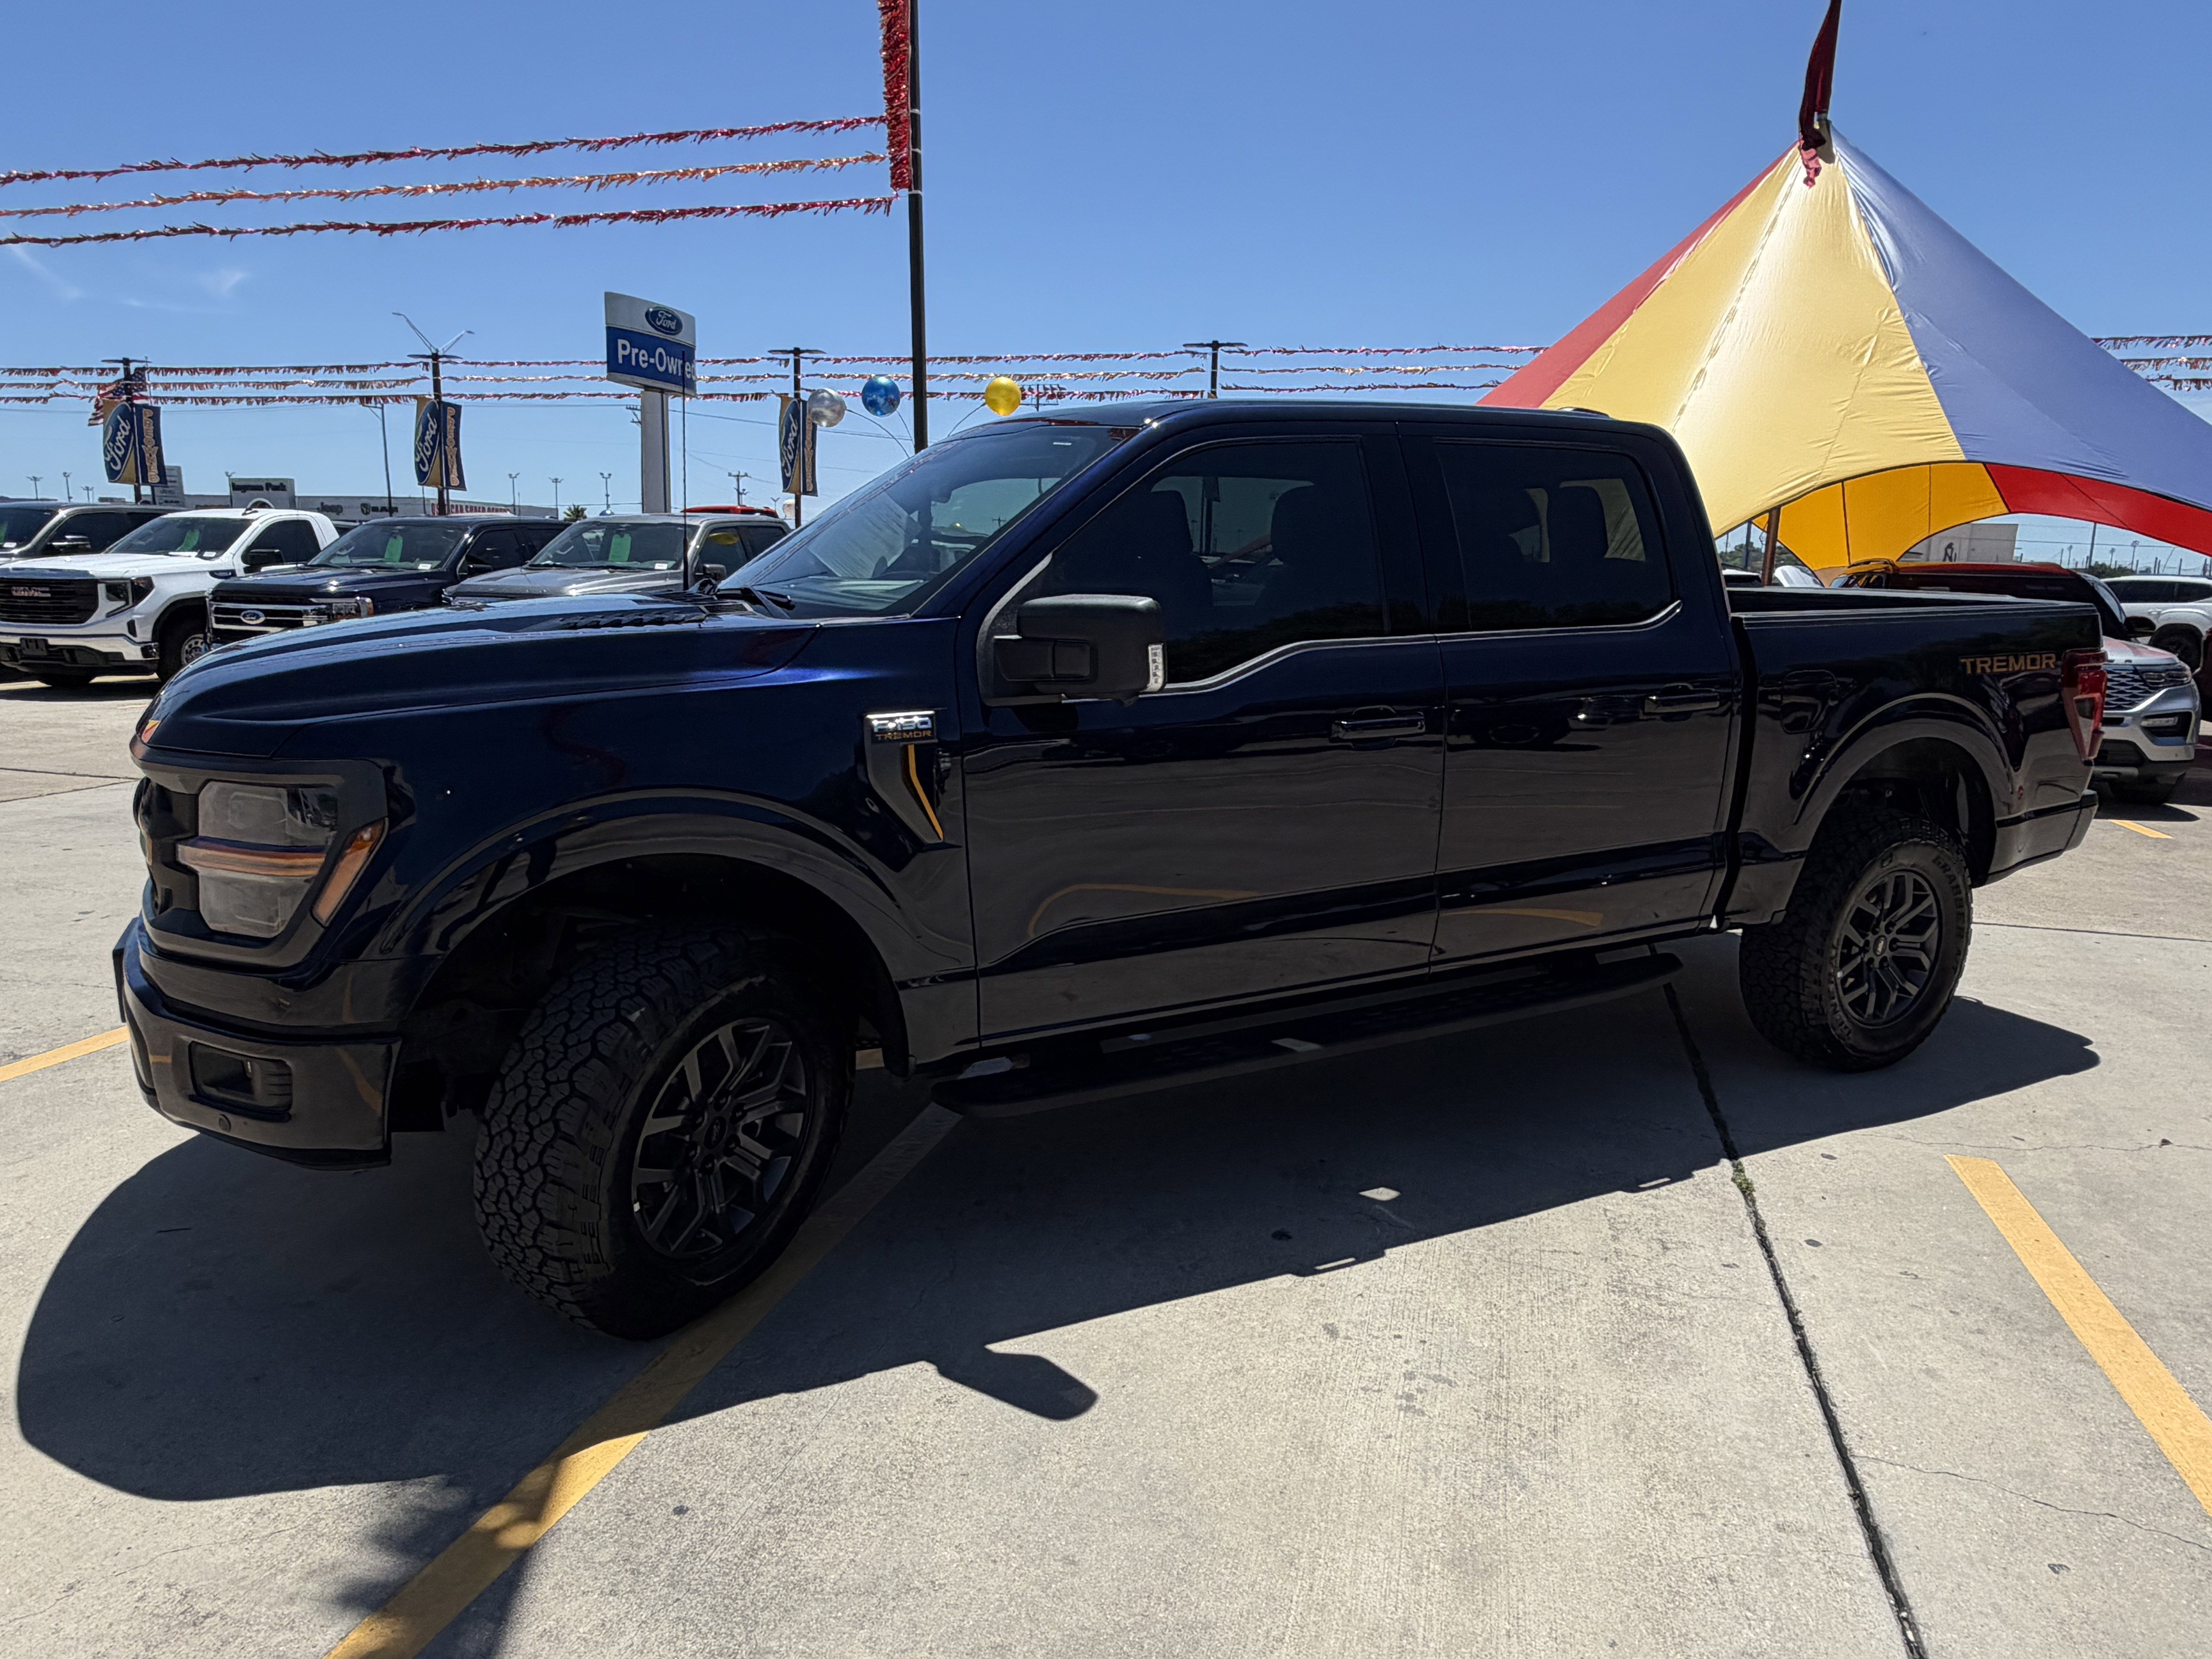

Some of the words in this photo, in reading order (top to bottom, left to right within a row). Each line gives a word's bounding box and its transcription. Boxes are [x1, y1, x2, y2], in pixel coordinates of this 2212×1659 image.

[656, 310, 677, 330] Ford
[104, 414, 131, 471] Ford
[415, 413, 438, 472] Ford
[781, 413, 802, 477] Ford
[316, 501, 343, 516] Jeep
[11, 586, 51, 597] GMC
[1960, 653, 2056, 674] TREMOR
[875, 730, 931, 740] TREMOR
